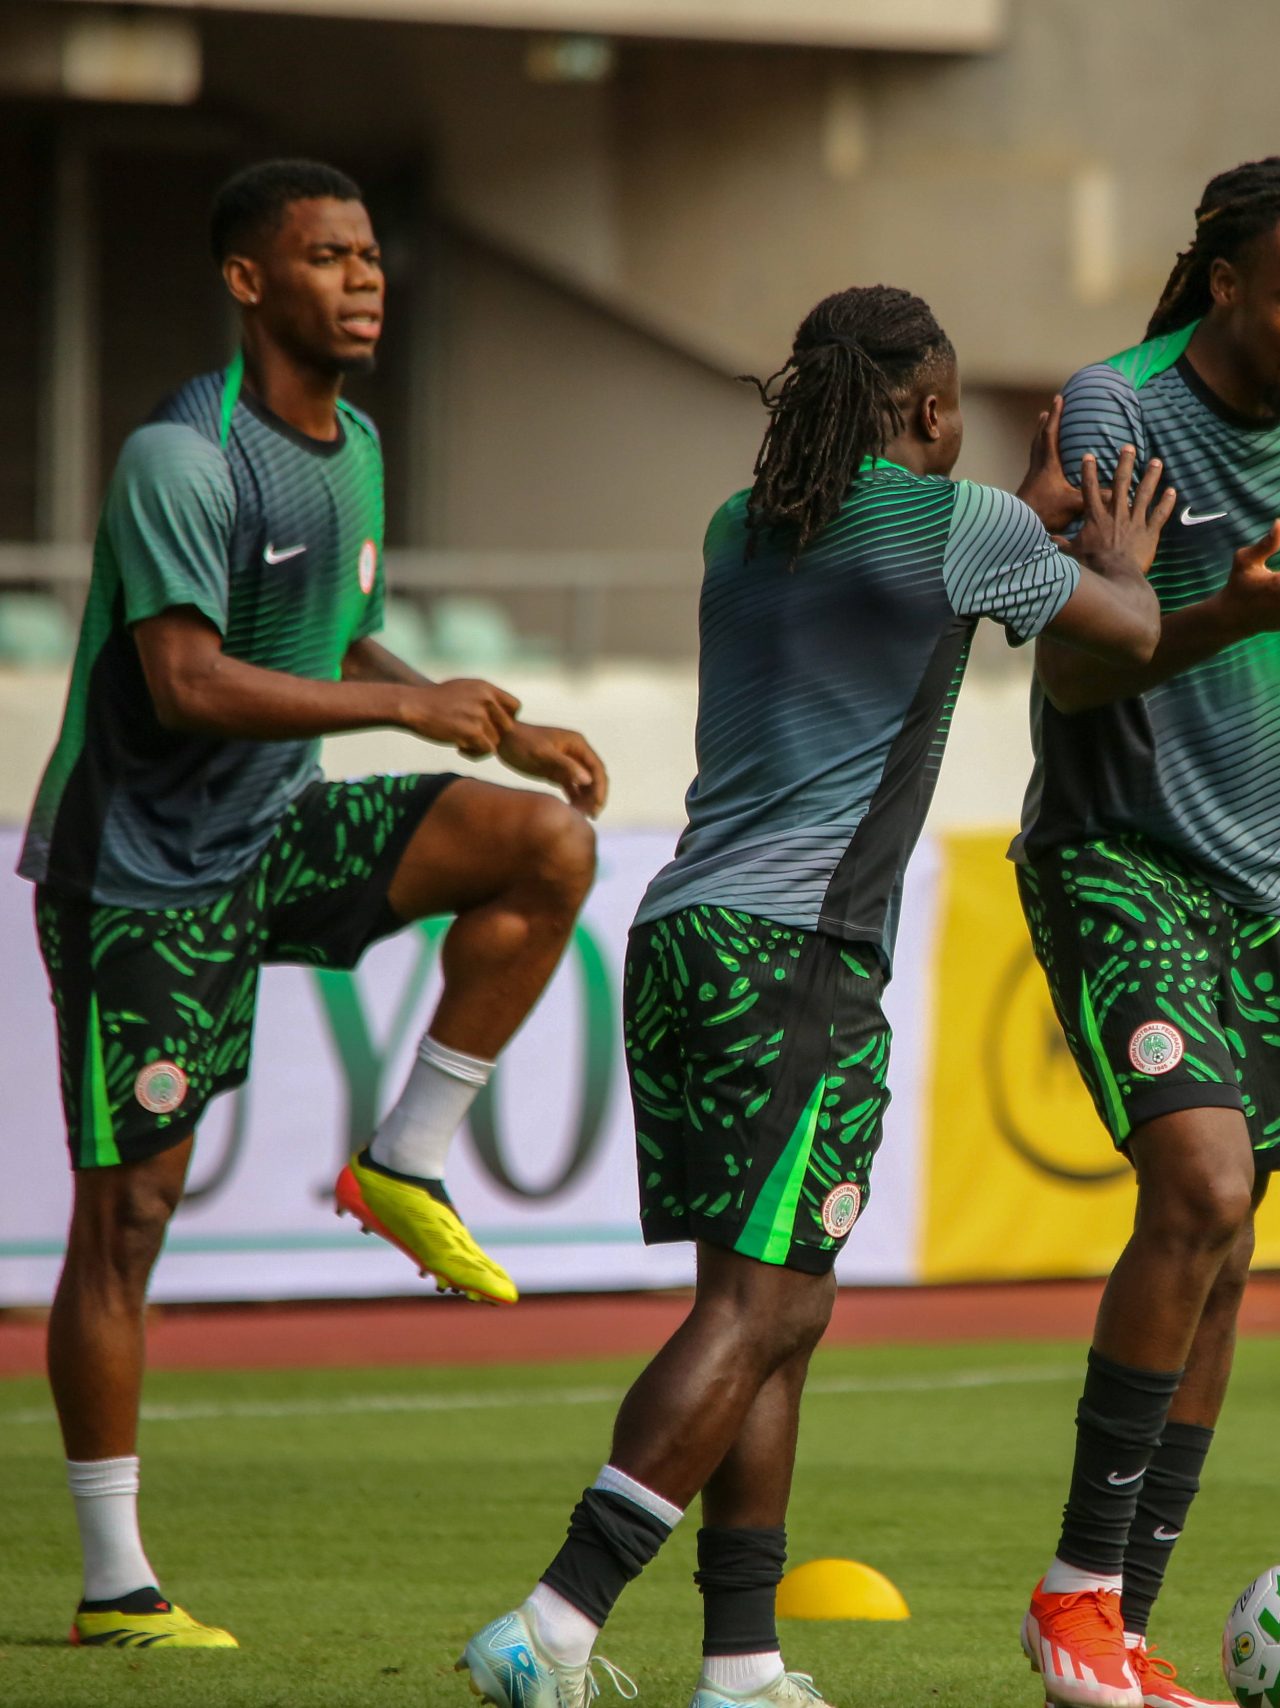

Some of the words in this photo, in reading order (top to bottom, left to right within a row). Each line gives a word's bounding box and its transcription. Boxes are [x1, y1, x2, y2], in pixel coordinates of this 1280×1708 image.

[1132, 1025, 1160, 1047] FOOTBALL
[1161, 1026, 1181, 1059] FEDERATION
[180, 910, 618, 1209] YO
[1131, 1046, 1146, 1070] NIGERIA
